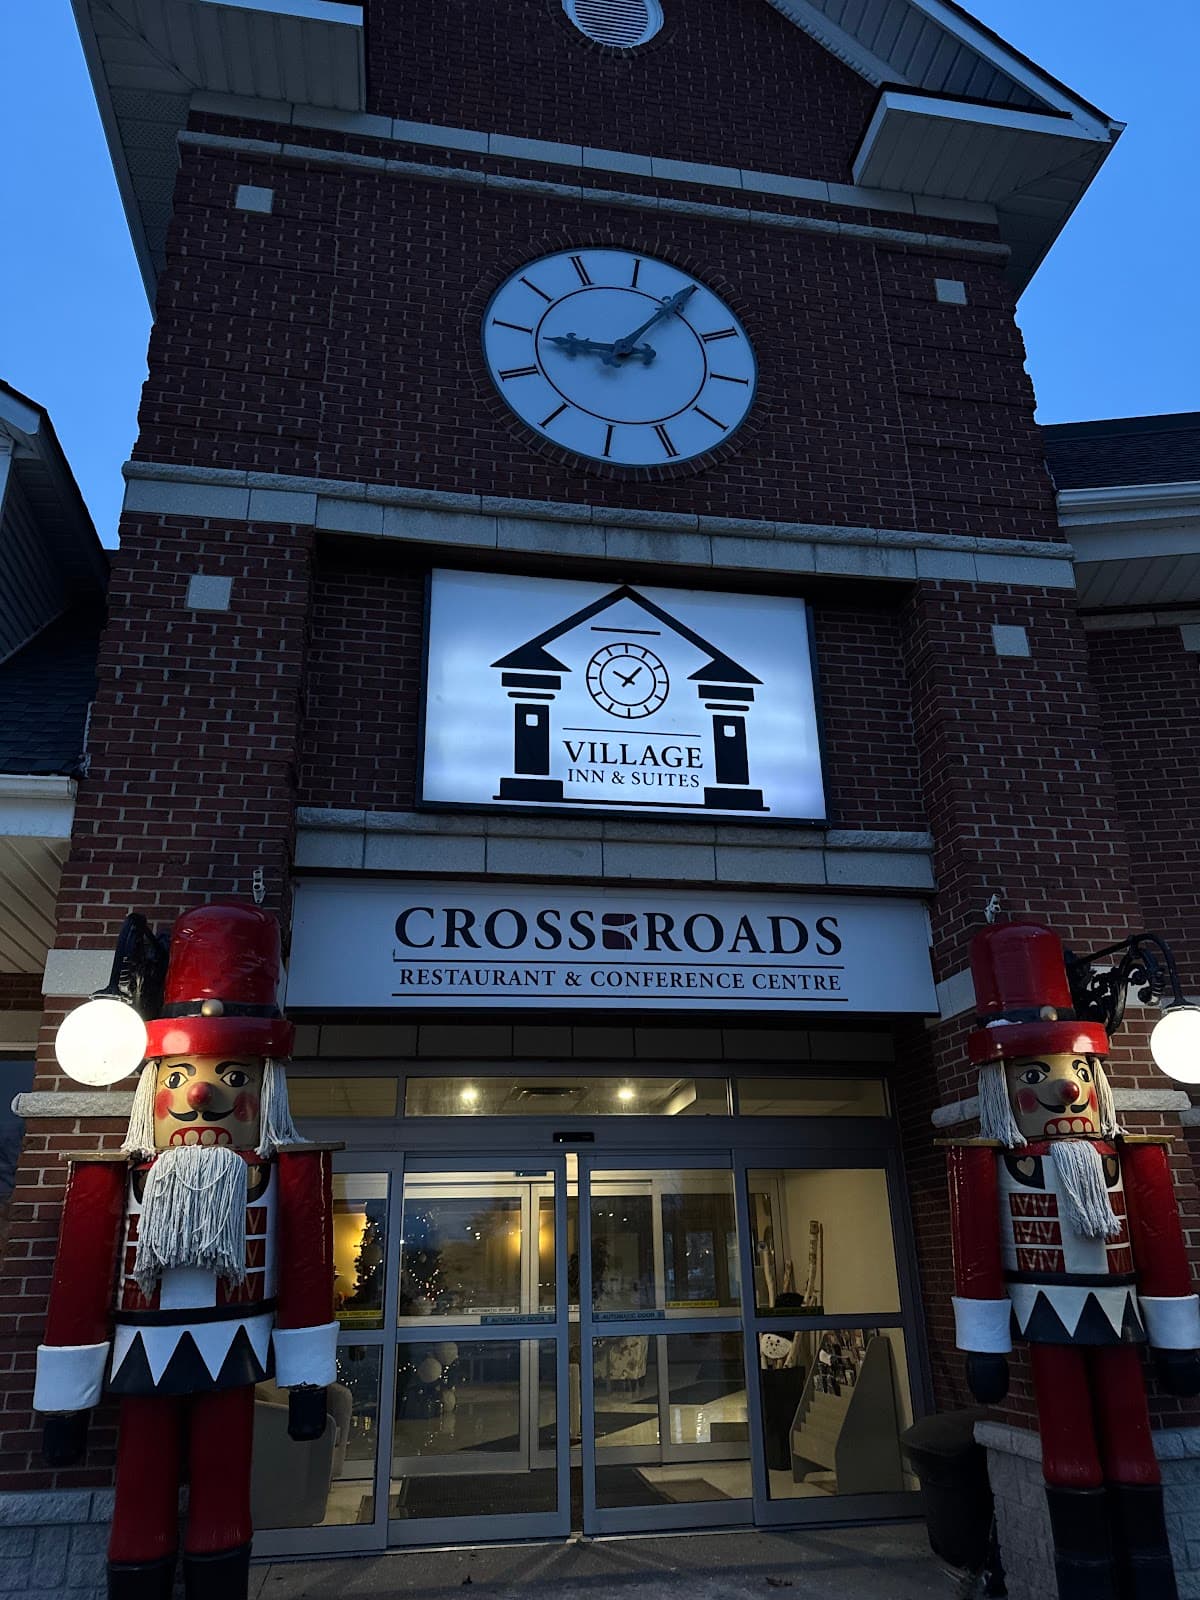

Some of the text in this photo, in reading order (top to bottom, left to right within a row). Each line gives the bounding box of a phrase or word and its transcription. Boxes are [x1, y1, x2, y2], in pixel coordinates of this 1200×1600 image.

[562, 740, 704, 769] VILLAGE
[567, 768, 700, 788] INN & SUITES
[399, 968, 841, 991] RESTAURANT & CONFERENCE CENTRE
